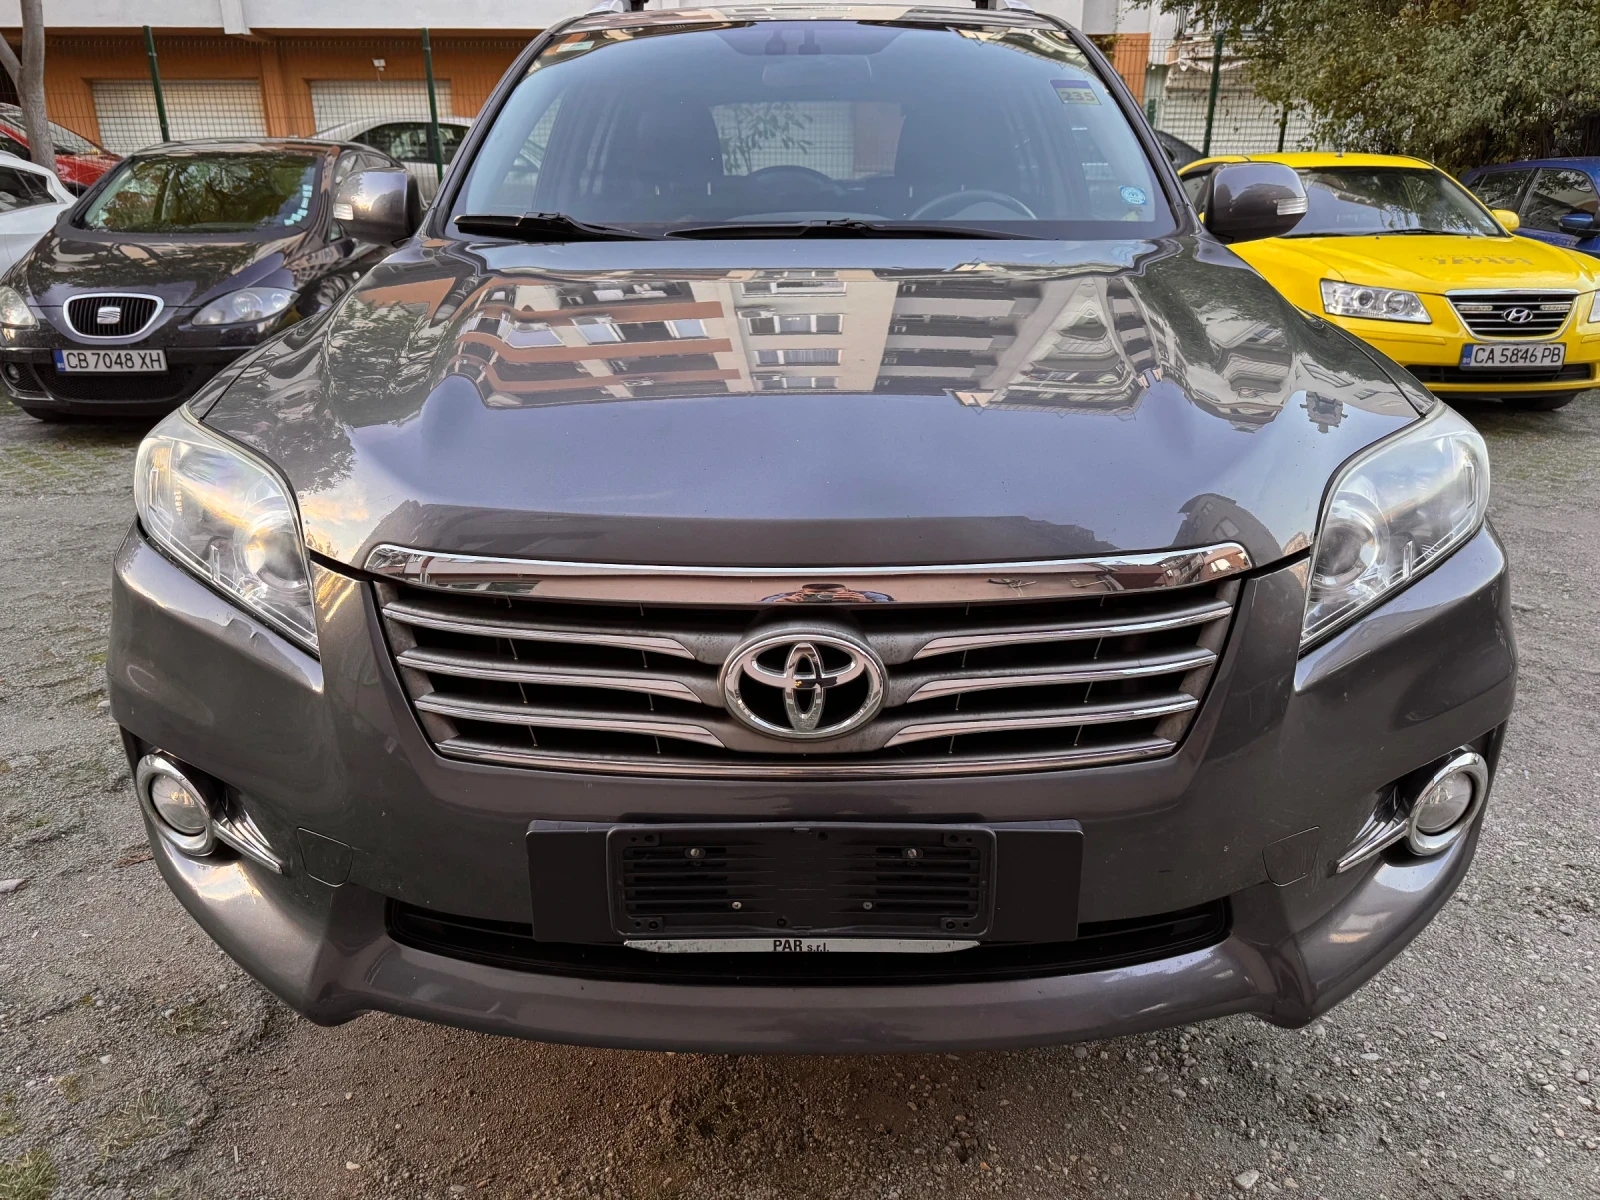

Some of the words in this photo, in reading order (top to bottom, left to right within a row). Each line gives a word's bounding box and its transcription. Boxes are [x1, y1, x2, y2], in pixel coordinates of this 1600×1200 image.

[1061, 91, 1096, 101] 235
[66, 352, 89, 369] CB
[91, 352, 135, 369] 7048
[137, 352, 162, 369] XH
[1474, 348, 1495, 364] CA
[1499, 347, 1538, 364] 5846
[1540, 347, 1561, 363] PB
[773, 939, 803, 952] PAR
[806, 942, 830, 952] s.r.l.
